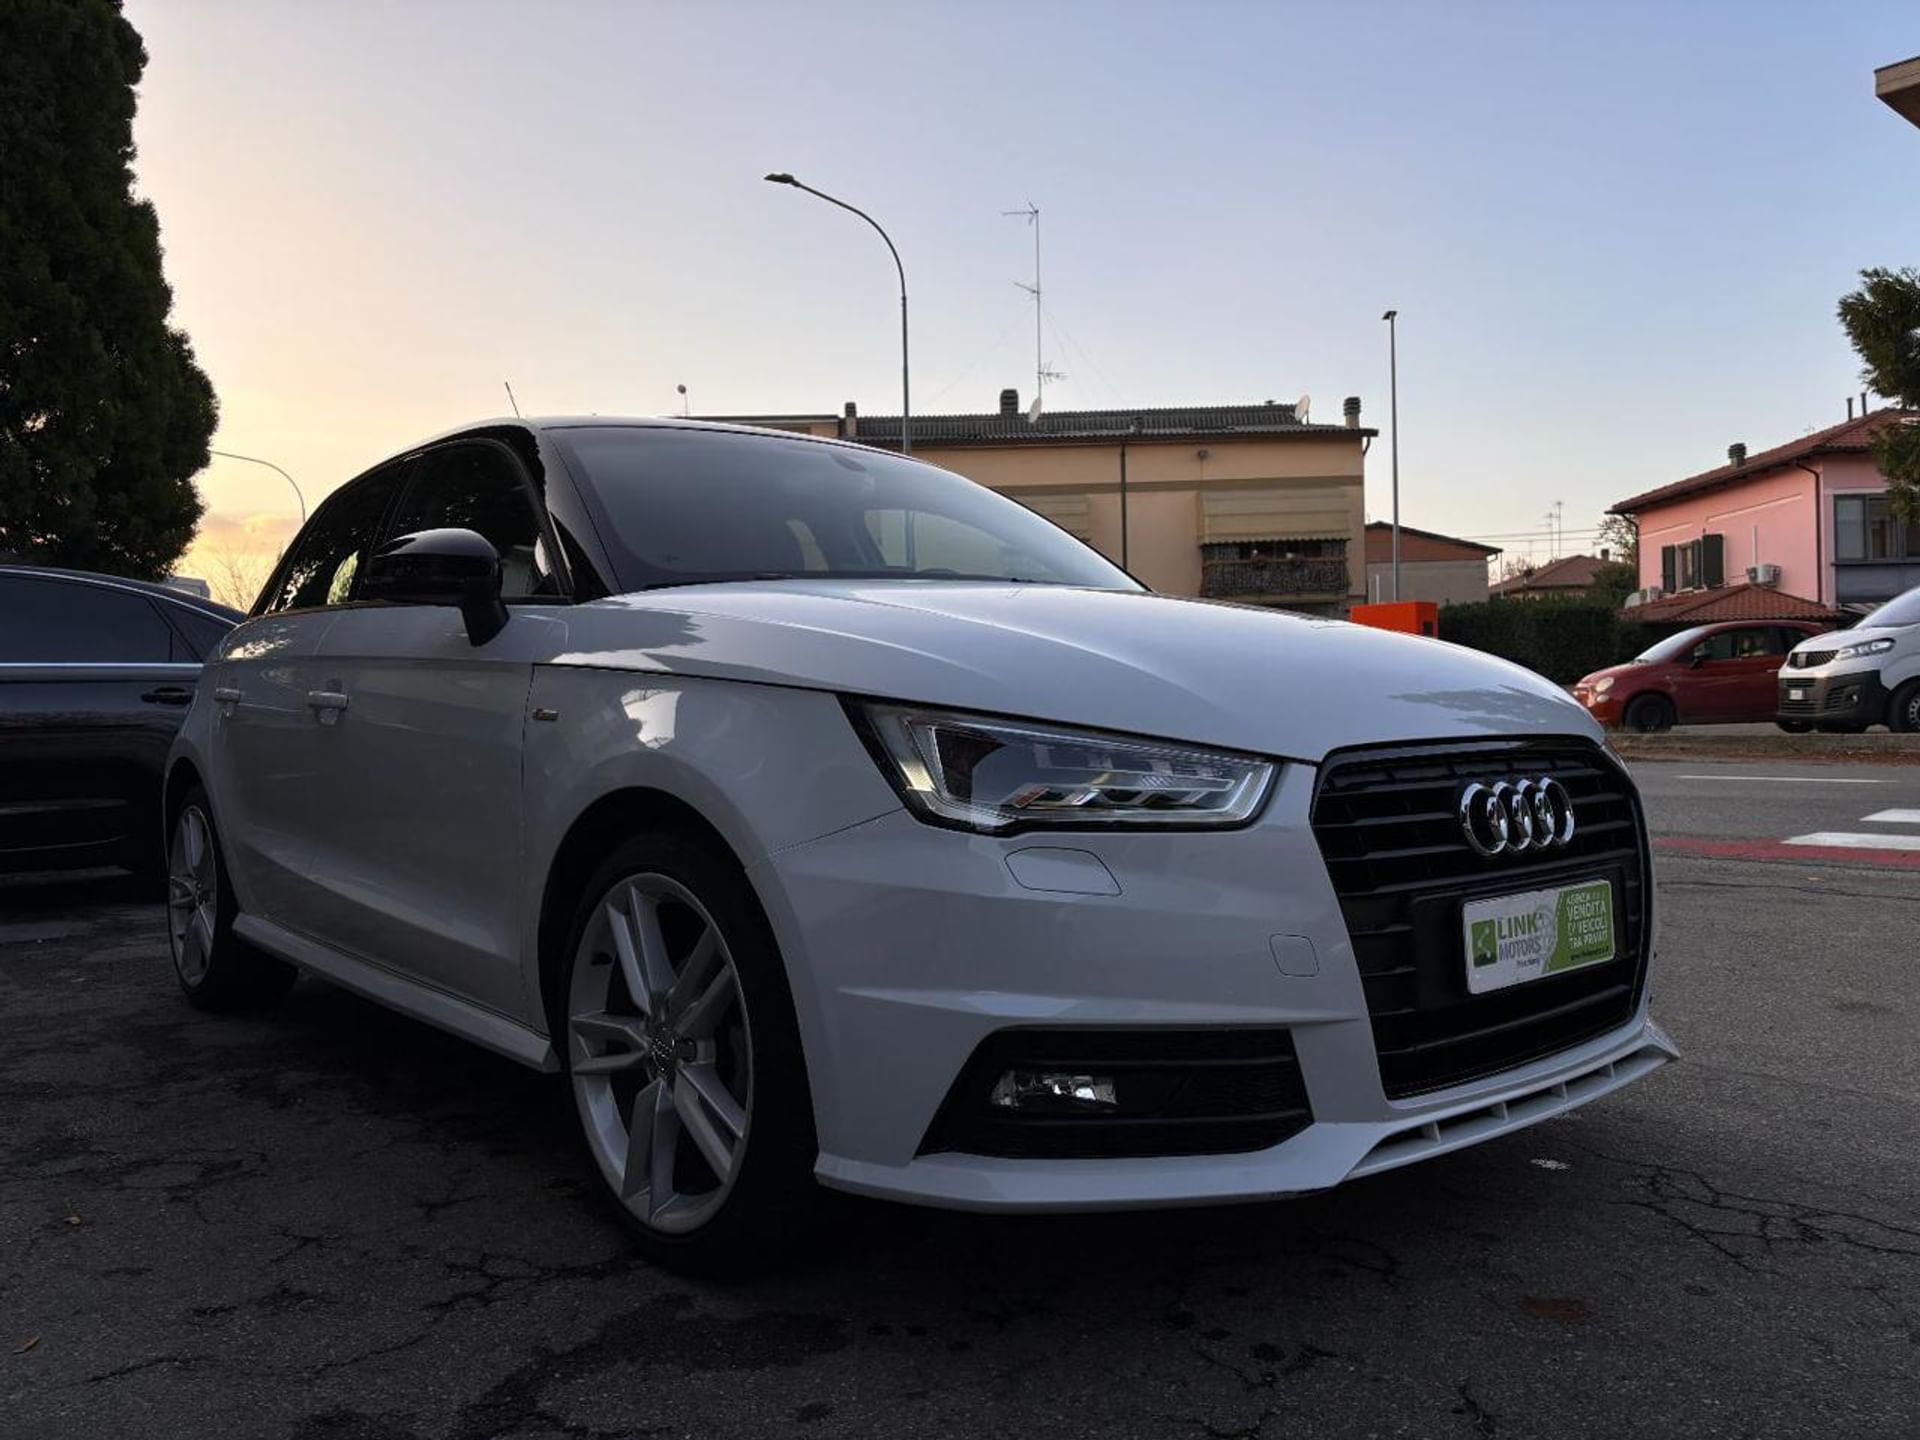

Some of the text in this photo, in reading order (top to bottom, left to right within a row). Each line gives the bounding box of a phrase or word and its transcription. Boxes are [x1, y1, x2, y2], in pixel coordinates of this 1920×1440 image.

[1567, 901, 1607, 921] VENDITA
[1498, 912, 1537, 939] LINK
[1499, 937, 1541, 960] MOTORS
